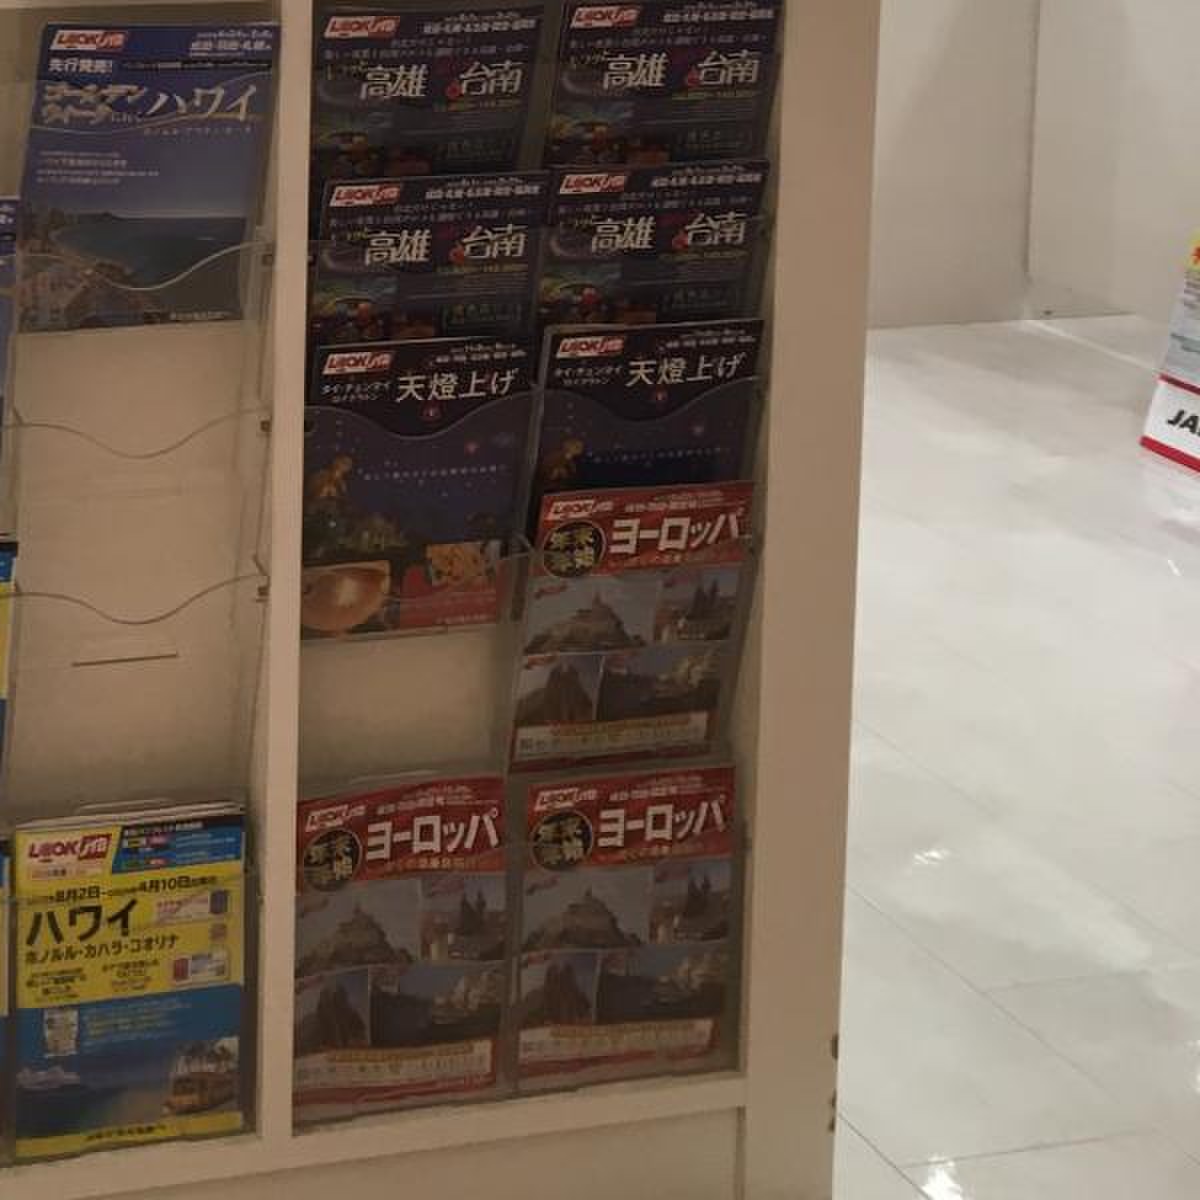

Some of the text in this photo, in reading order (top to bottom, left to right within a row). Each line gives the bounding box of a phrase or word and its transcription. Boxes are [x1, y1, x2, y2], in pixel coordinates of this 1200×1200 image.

[360, 60, 525, 99] 高雄 台南
[603, 49, 761, 90] 高雄 台南
[146, 84, 257, 122] ハワイ
[365, 224, 528, 265] 高雄 台南
[592, 212, 747, 252] 高雄 台南
[396, 368, 520, 402] 天燈上げ
[626, 352, 747, 387] 天燈上げ
[1167, 410, 1200, 437] JA
[609, 507, 745, 555] ヨーロッパ
[366, 805, 500, 862] ヨーロッパ
[598, 793, 727, 849] ヨーロッパ
[26, 900, 138, 946] ハワイ
